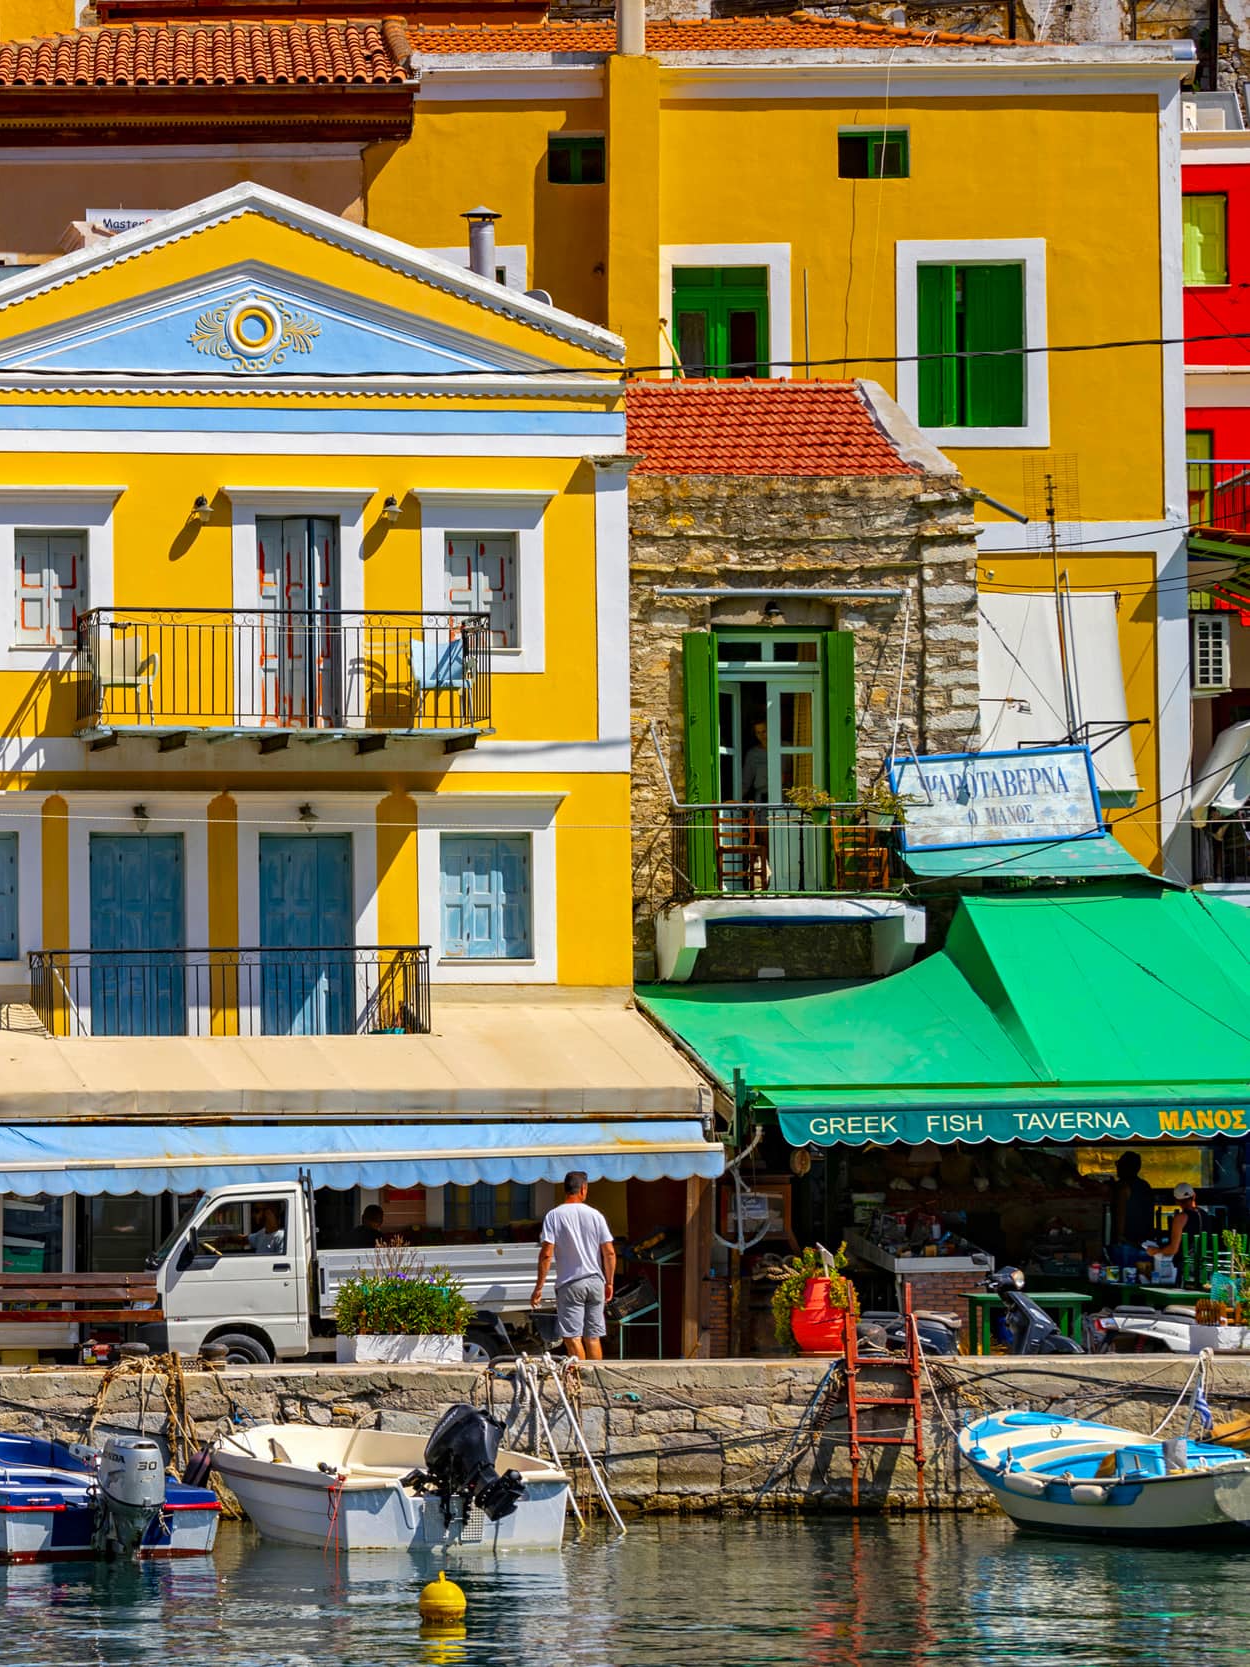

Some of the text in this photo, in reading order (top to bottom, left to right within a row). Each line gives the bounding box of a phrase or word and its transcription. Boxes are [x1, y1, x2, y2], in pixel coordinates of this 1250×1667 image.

[102, 218, 153, 229] Master
[809, 1109, 1247, 1136] GREEK FISH TAVERNA ΜΑΝΟΣ
[137, 1461, 157, 1471] 30
